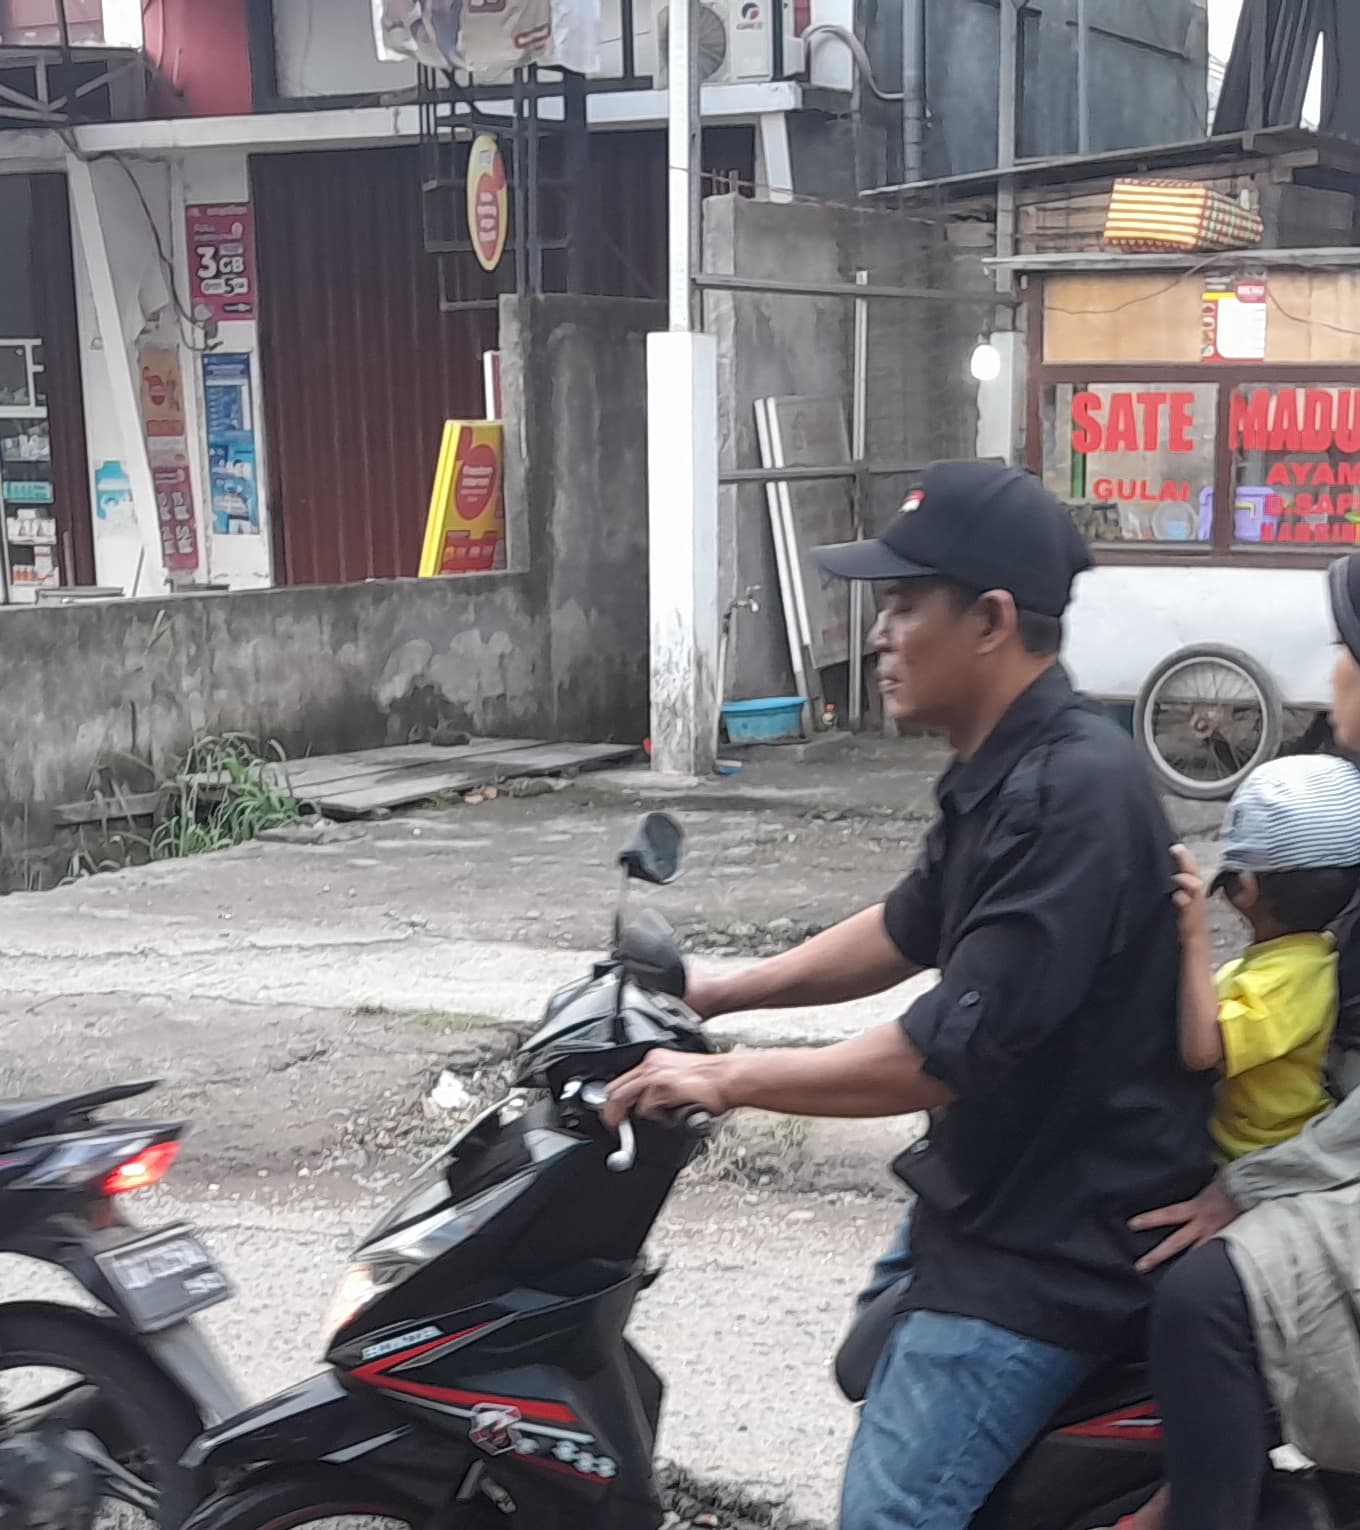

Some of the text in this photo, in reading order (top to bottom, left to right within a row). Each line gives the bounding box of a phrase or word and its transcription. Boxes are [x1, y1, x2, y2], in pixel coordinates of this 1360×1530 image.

[196, 245, 245, 279] 3 GB
[224, 276, 236, 295] 5
[1071, 389, 1194, 454] SATE
[1092, 477, 1190, 502] GULAI
